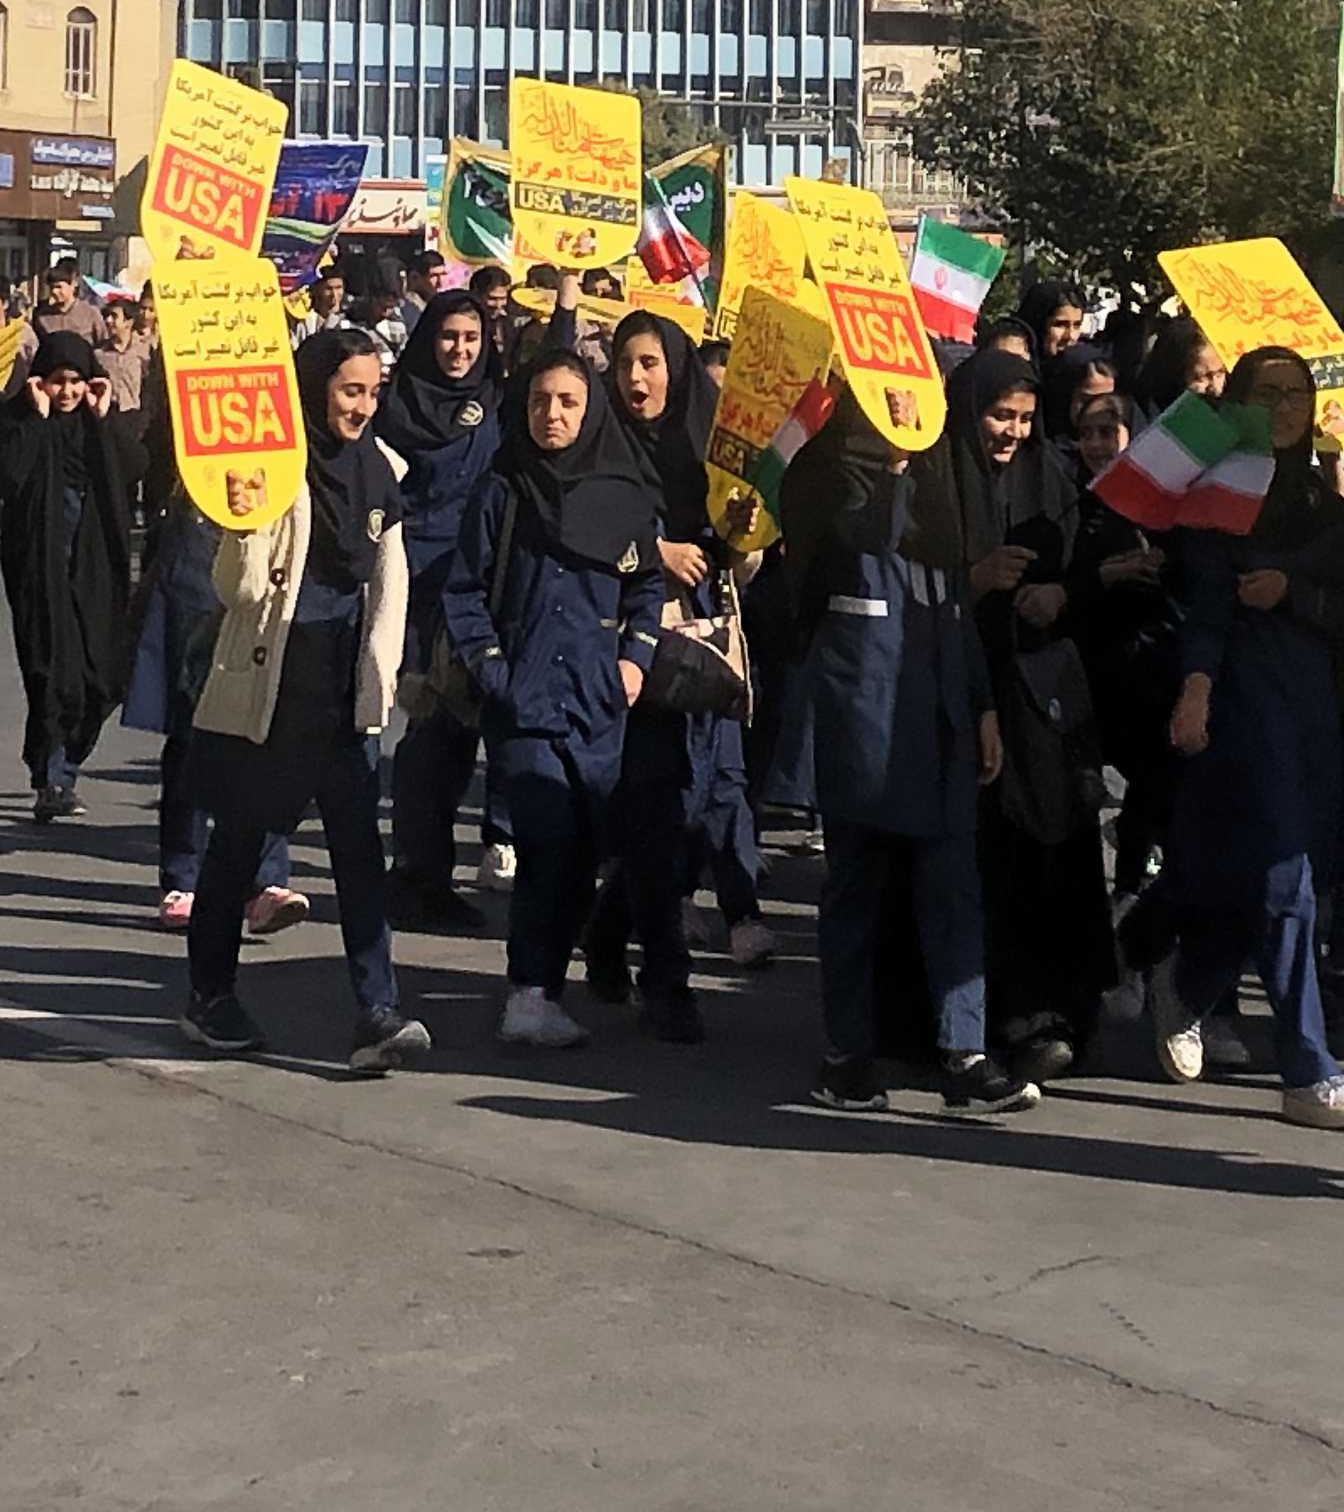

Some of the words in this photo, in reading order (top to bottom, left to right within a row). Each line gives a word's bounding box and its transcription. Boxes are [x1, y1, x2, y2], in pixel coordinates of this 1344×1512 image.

[171, 152, 216, 180] DOWN
[218, 172, 257, 200] WITH
[163, 168, 245, 241] USA
[519, 189, 566, 214] USA
[157, 279, 198, 306] آمریکا
[189, 309, 221, 334] کشور
[840, 307, 925, 374] USA
[186, 372, 234, 392] DOWN
[239, 371, 279, 389] WITH
[188, 389, 286, 447] USA
